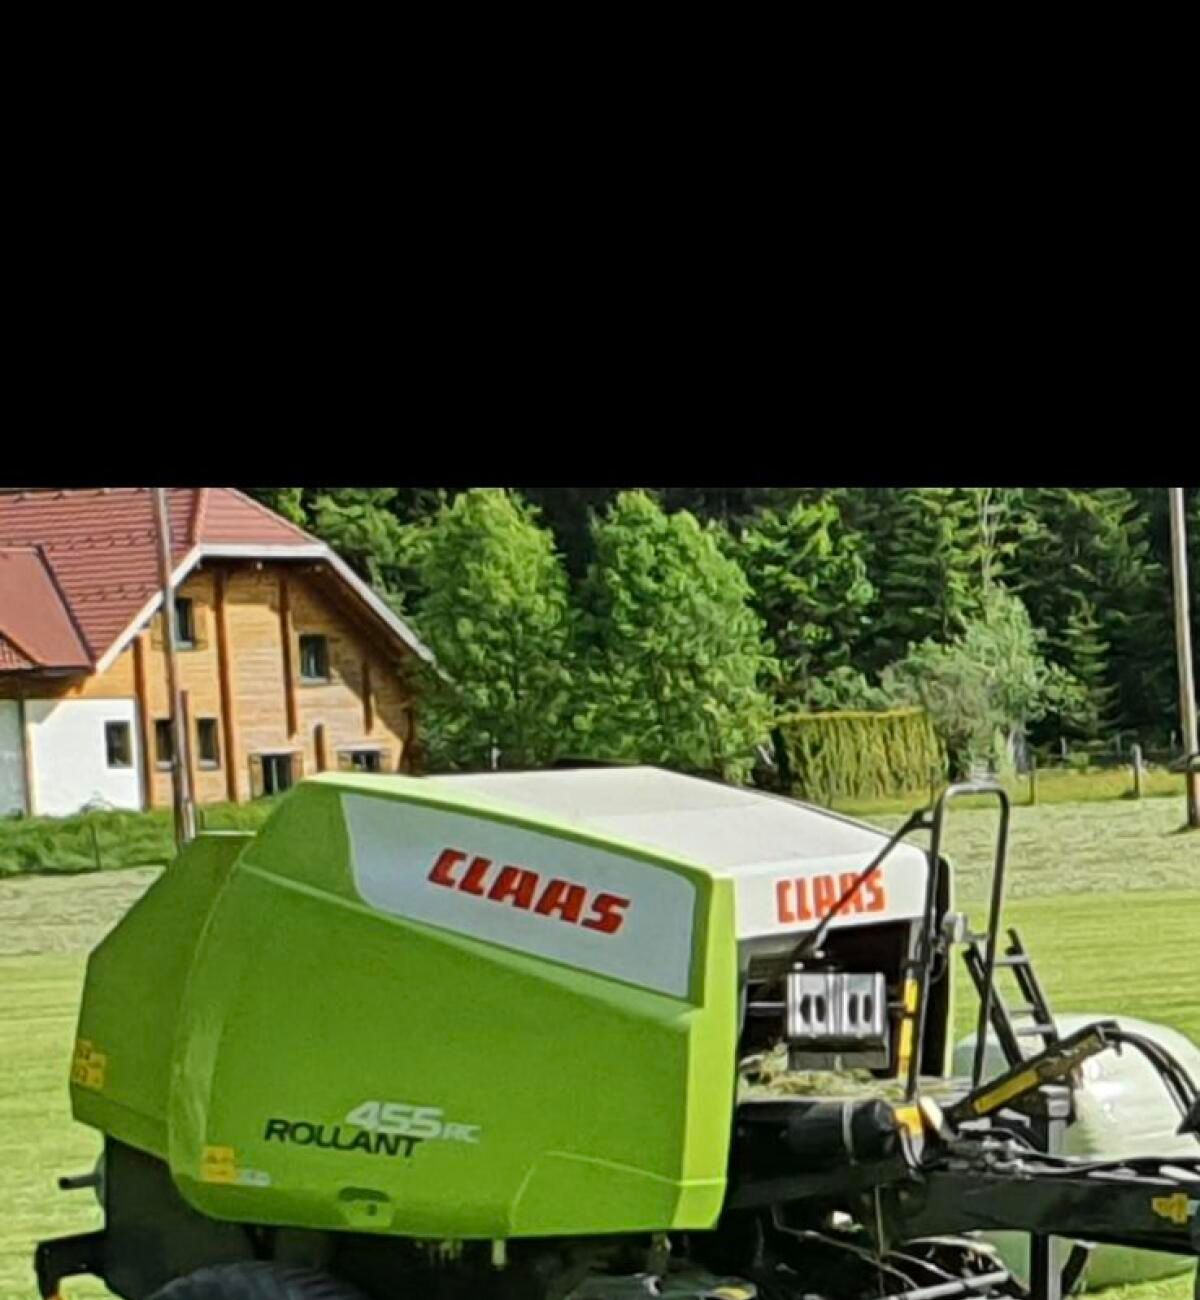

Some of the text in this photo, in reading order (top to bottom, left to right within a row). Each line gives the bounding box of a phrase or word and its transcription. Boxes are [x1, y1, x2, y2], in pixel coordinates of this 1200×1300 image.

[428, 848, 630, 934] CLAAS
[776, 870, 886, 924] CLAAS
[264, 1118, 425, 1157] ROLLANT
[346, 1100, 444, 1139] 455
